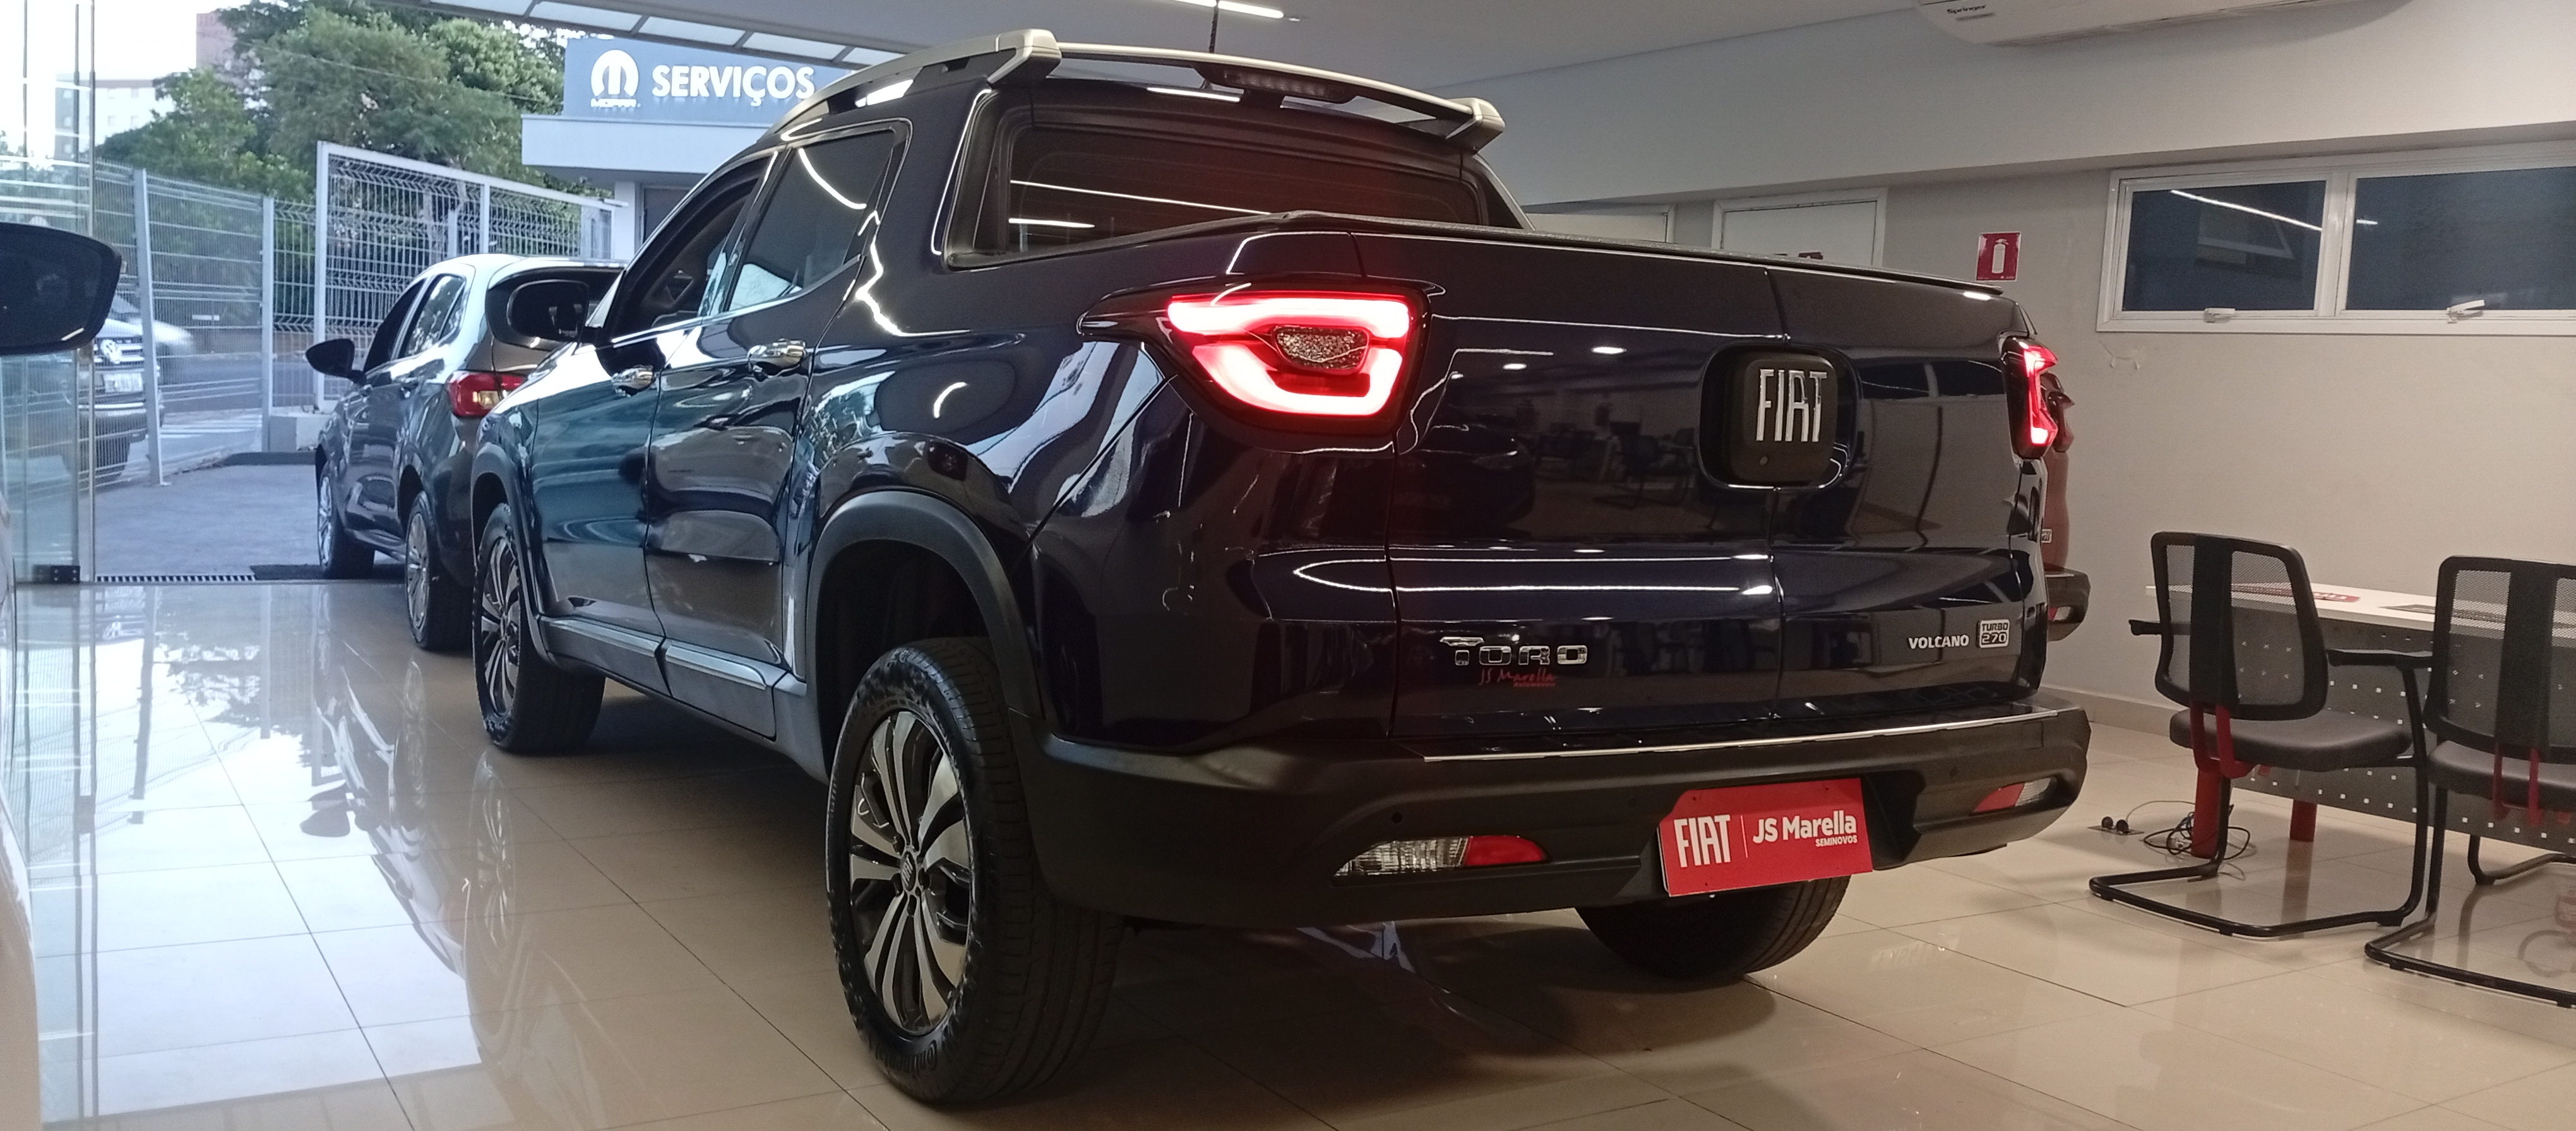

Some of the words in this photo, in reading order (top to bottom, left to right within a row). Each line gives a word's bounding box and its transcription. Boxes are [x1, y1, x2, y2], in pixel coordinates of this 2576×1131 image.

[652, 65, 814, 107] SERVIÇOS
[1756, 369, 1827, 442] FIAT
[1981, 622, 2008, 631] TURBO
[1907, 634, 1969, 649] VOLCANO
[1981, 632, 2007, 644] 270
[1439, 636, 1589, 666] TORO
[1497, 667, 1556, 683] Marella
[1674, 814, 1731, 868] FIAT
[1752, 818, 1779, 844] JS
[1782, 810, 1857, 840] Marella
[1815, 834, 1858, 847] SEMINOVOS
